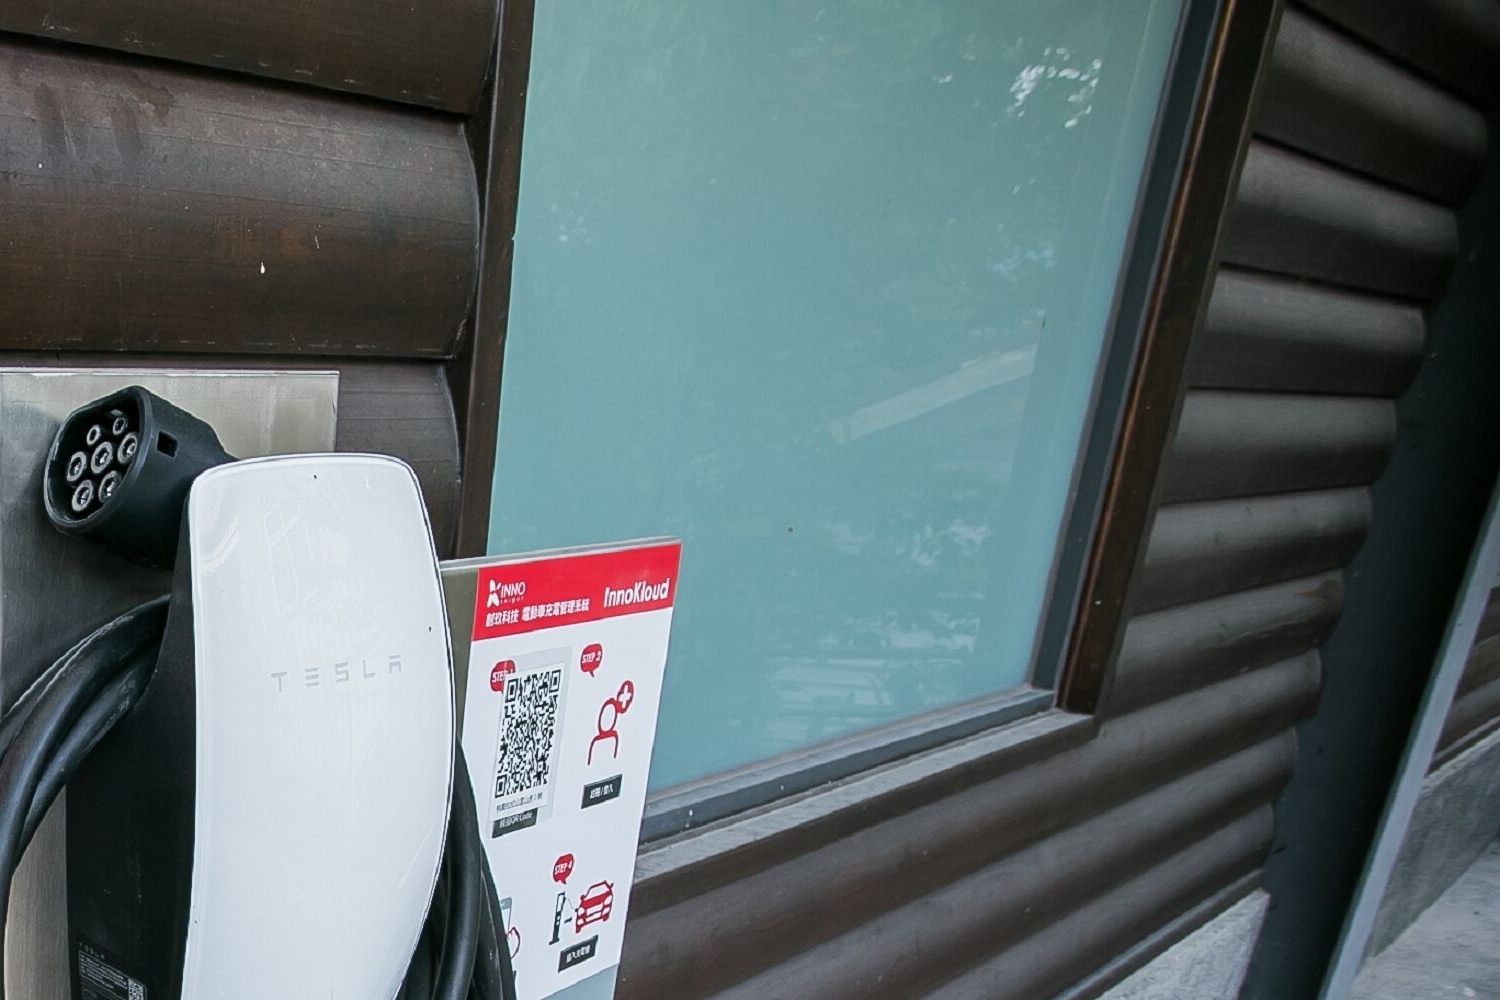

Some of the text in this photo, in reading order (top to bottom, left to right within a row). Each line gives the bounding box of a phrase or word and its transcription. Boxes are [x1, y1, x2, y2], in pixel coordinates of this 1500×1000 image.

[501, 582, 526, 598] INNO
[603, 578, 670, 608] InnoKloud
[582, 651, 596, 664] STEP
[270, 655, 402, 692] TESLA
[554, 862, 568, 875] STEP
